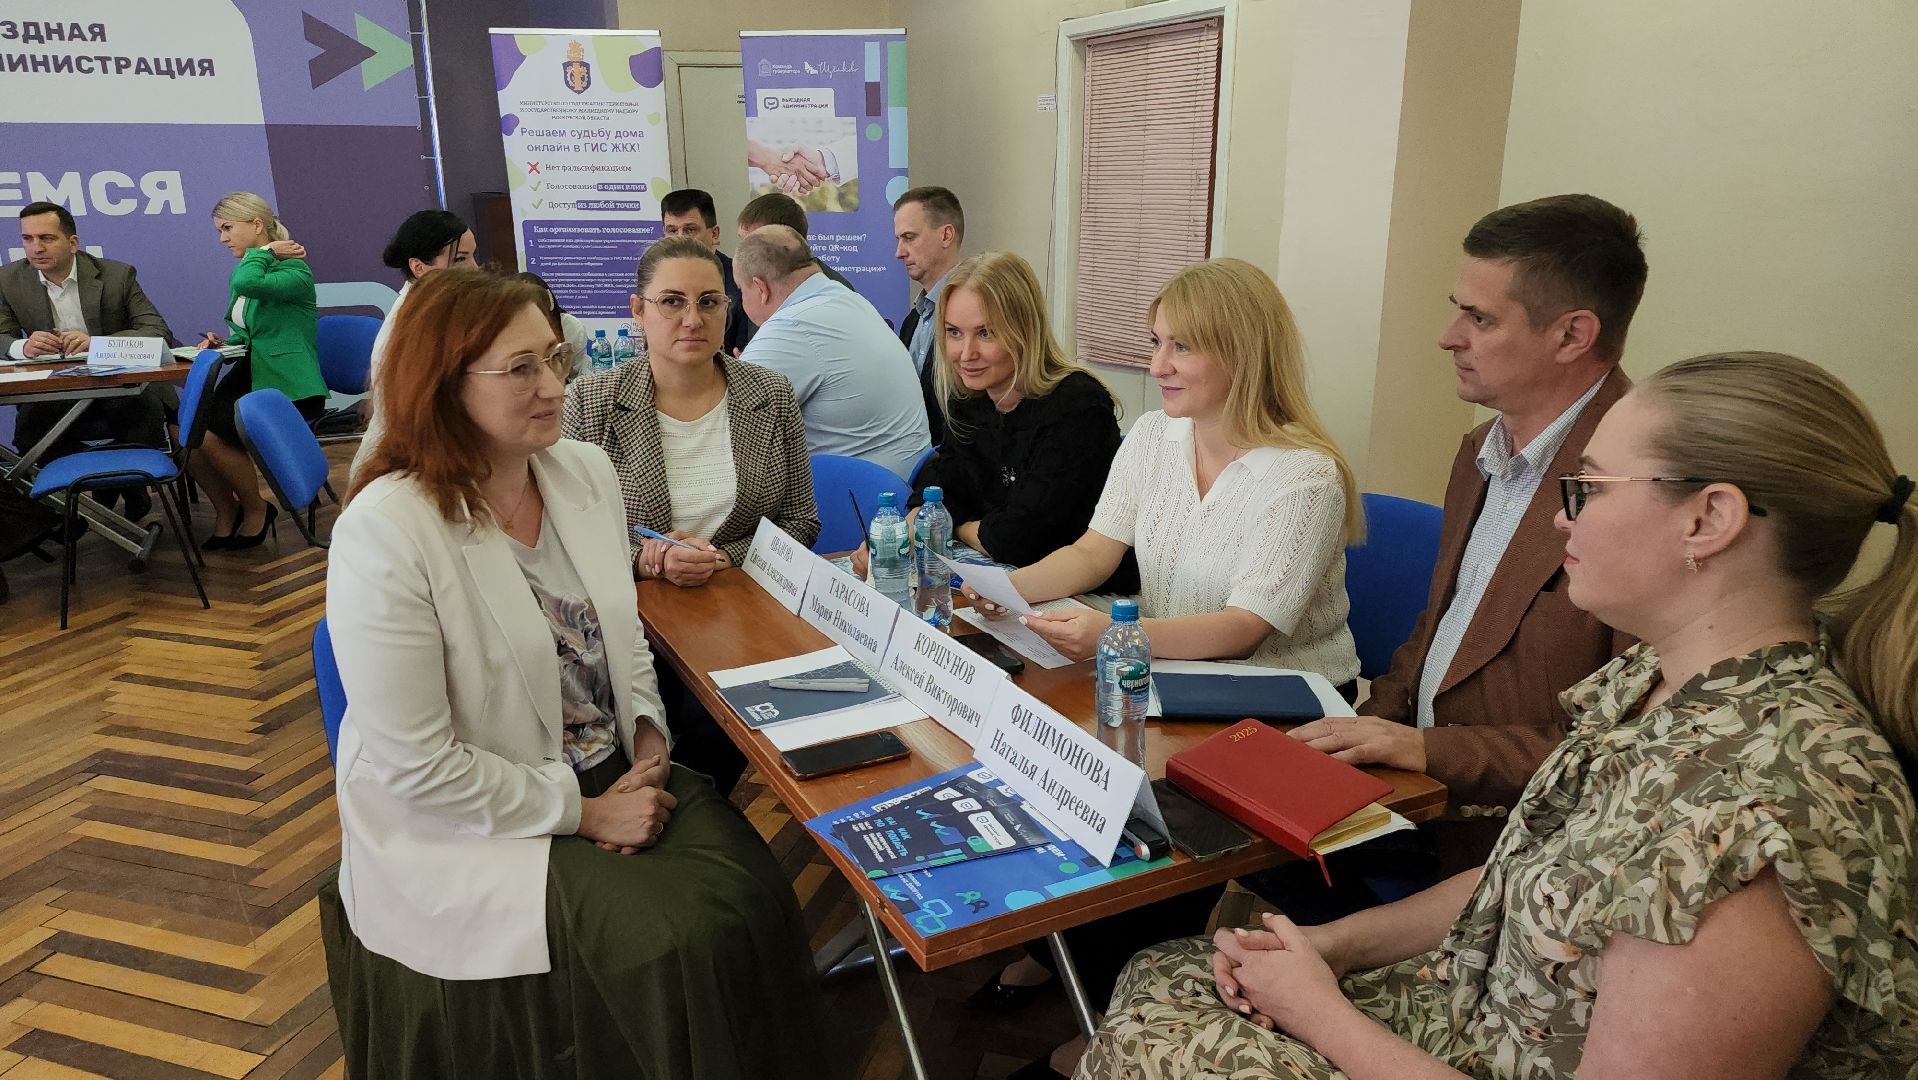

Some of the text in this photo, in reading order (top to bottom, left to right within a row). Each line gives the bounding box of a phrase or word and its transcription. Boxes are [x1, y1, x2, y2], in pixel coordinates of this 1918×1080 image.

[521, 128, 645, 140] Решаем судьбу дома
[527, 143, 641, 153] онлайн в ГИС ЖКХ!
[604, 183, 624, 191] один
[548, 202, 576, 210] Доступ
[588, 201, 615, 209] любой
[602, 226, 654, 235] голосование?
[529, 239, 534, 247] 1
[818, 233, 835, 241] был
[836, 233, 867, 242] решен?
[828, 244, 859, 252] QR-код
[829, 576, 871, 617] ТАРАСОВА
[808, 594, 878, 653] Мария Николаевна
[913, 632, 976, 685] КОРШУНОВ
[890, 652, 981, 728] Алексей Викторович
[1010, 703, 1111, 792] ФИЛИМОНОВА
[990, 727, 1107, 835] Наталья Андреевна
